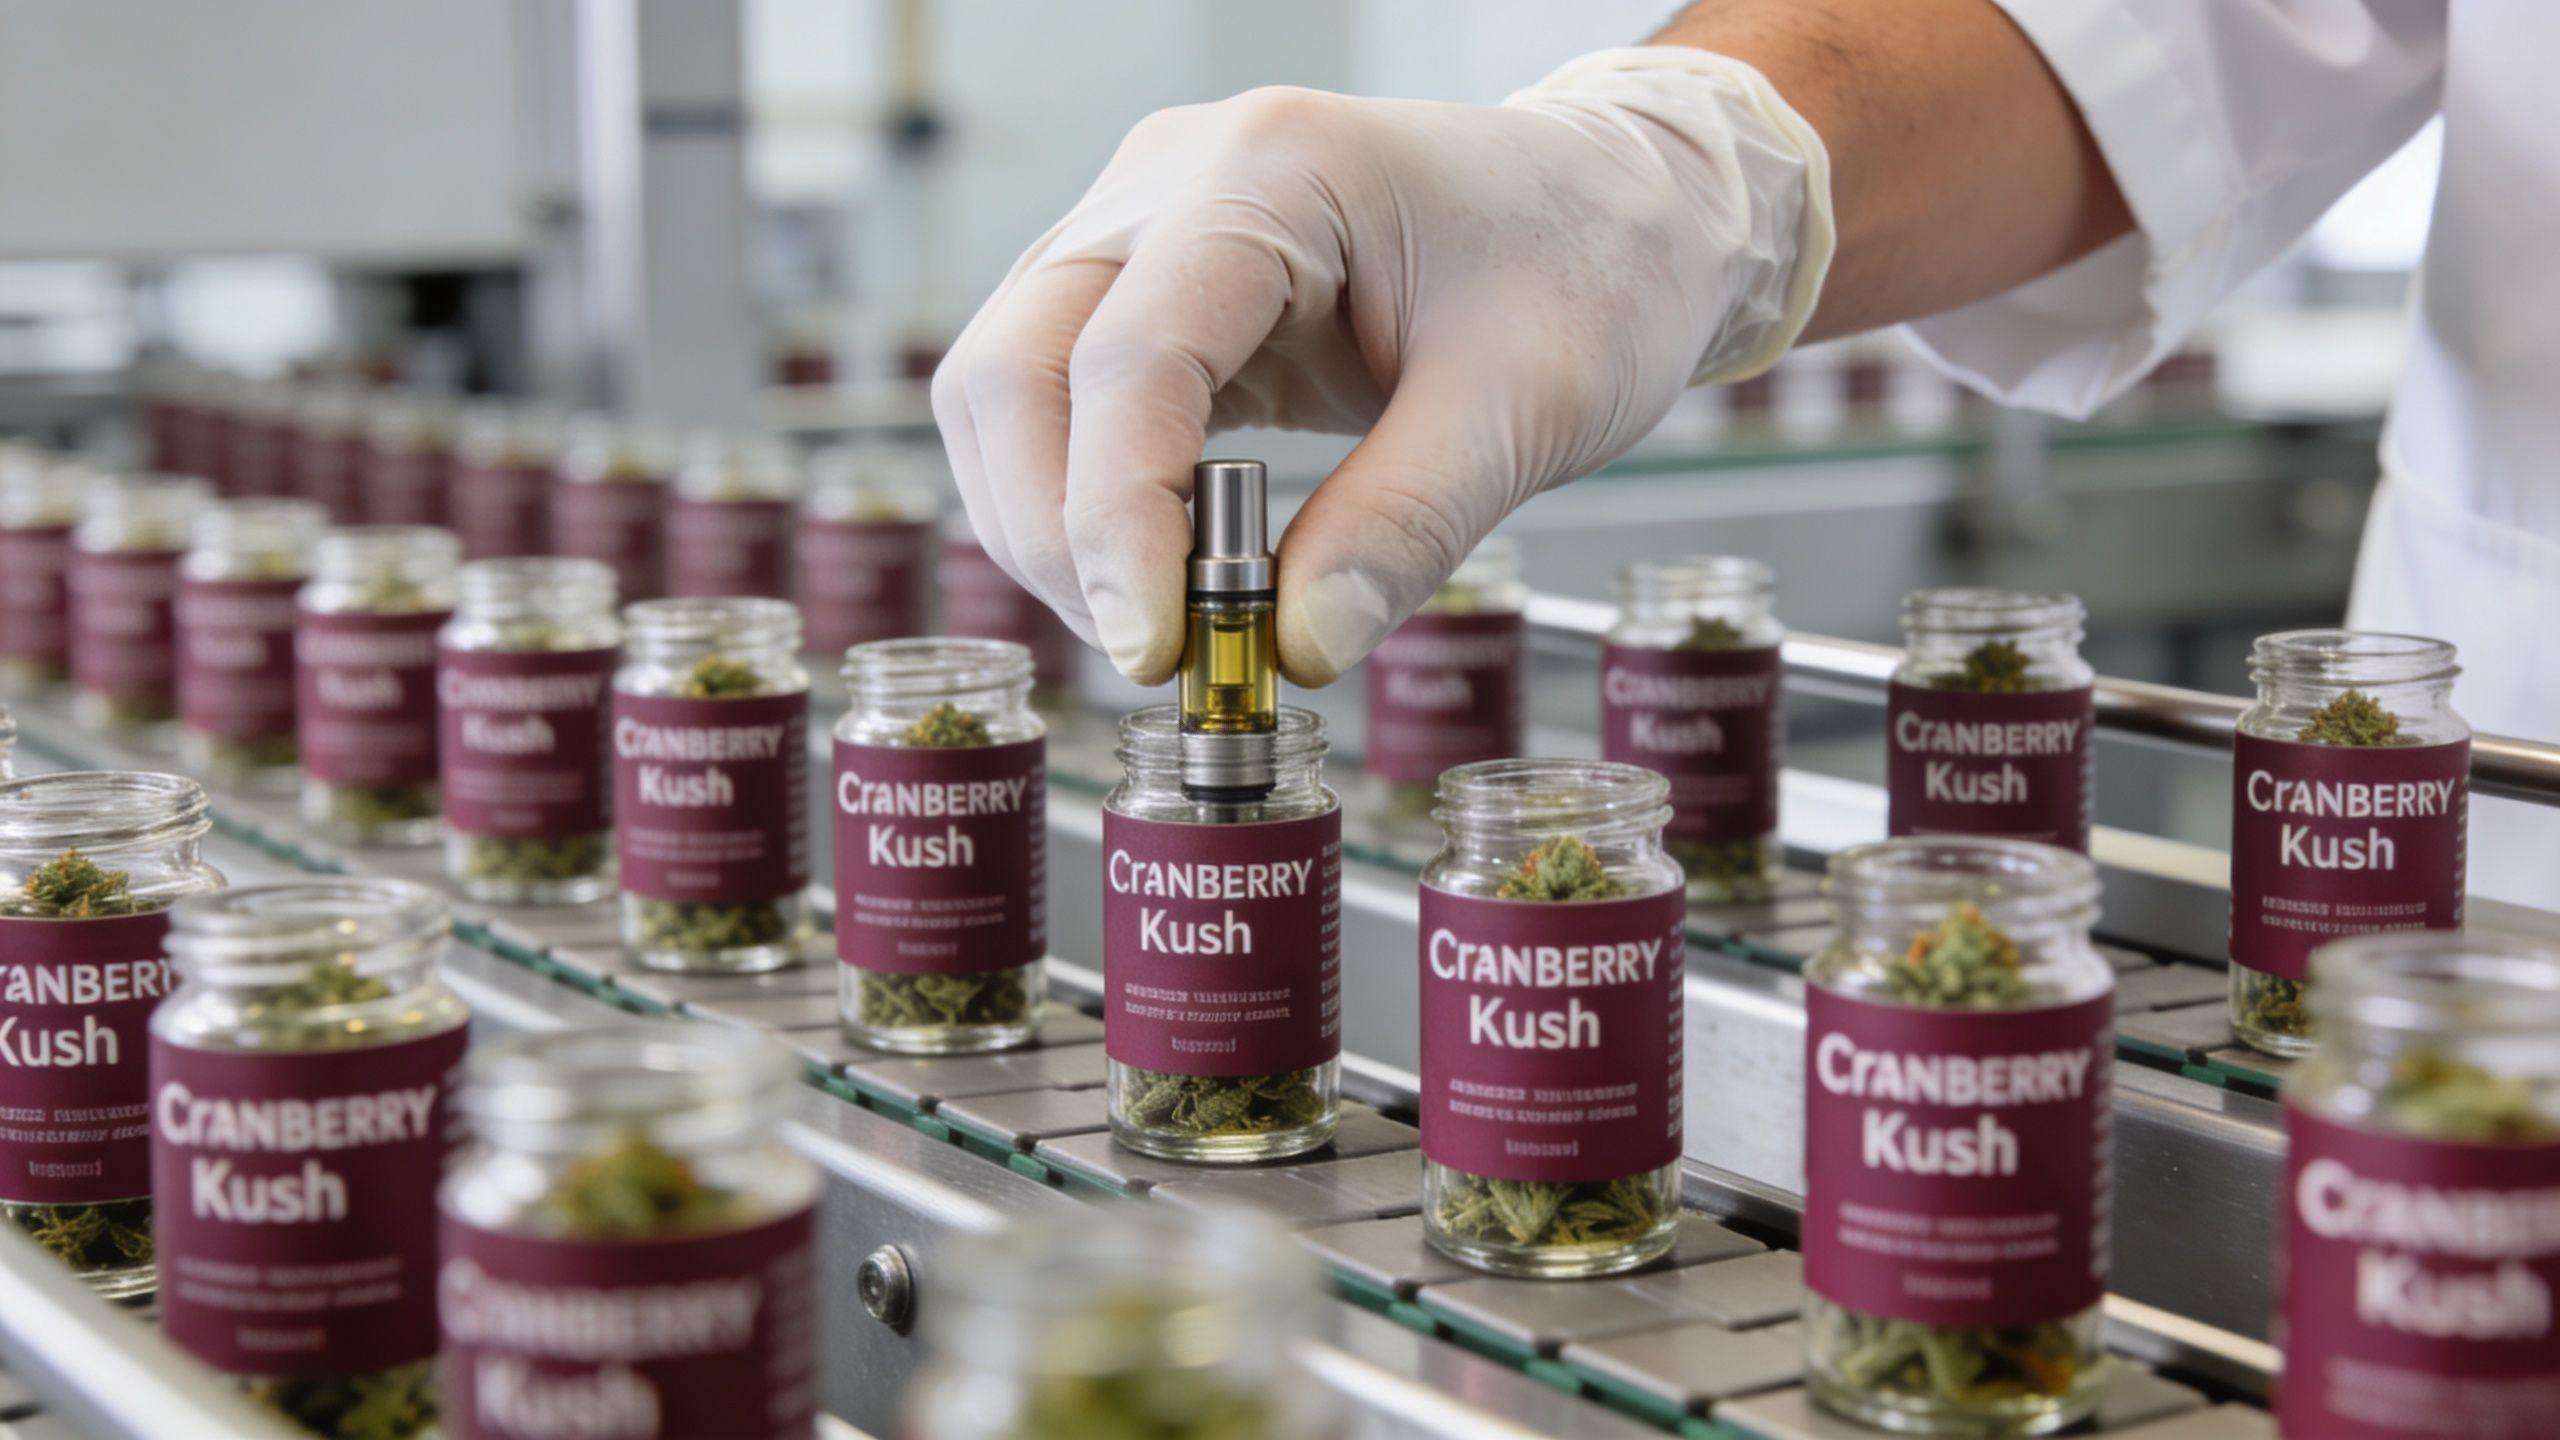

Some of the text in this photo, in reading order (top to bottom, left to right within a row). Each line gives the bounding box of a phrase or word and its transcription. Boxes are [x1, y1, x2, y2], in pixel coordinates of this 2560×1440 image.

[461, 714, 556, 755] Kush
[1629, 713, 1725, 755] Kush
[638, 766, 735, 808] Kush
[1924, 761, 2028, 805] Kush
[868, 823, 974, 869] Kush
[2280, 824, 2395, 871] Kush
[1140, 907, 1252, 955] Kush
[1469, 994, 1600, 1050] Kush
[1862, 1110, 2020, 1176] Kush
[190, 1158, 348, 1224] Kush
